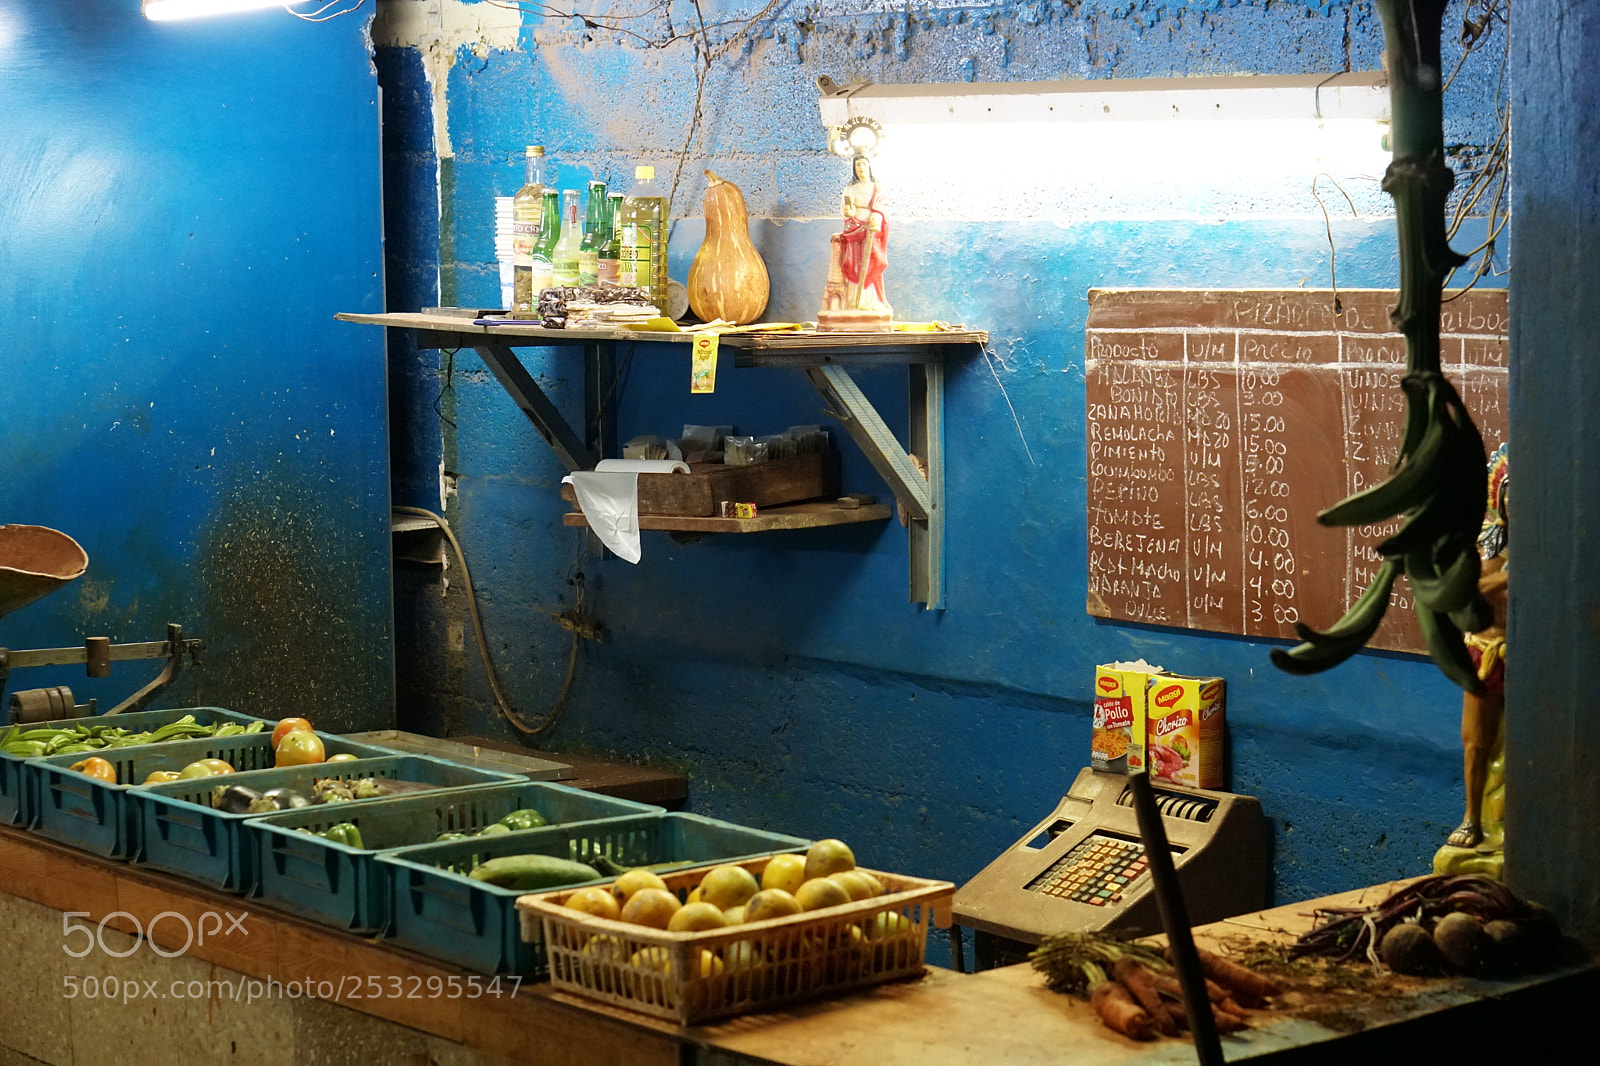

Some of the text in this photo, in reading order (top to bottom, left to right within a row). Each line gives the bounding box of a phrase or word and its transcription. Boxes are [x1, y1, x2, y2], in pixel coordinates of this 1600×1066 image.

[1187, 370, 1220, 389] LBS
[1243, 413, 1285, 432] 15.00
[1244, 434, 1287, 455] 15.00
[1190, 446, 1221, 468] U/M
[1245, 454, 1284, 474] 5.00
[1245, 499, 1288, 522] 6.00
[1193, 535, 1223, 559] U/M
[1249, 548, 1296, 574] 4.00
[1193, 563, 1226, 588] U/M
[1249, 576, 1295, 598] 4.00
[1089, 574, 1162, 600] NARANJA
[1194, 593, 1224, 614] U/M
[1104, 707, 1129, 721] Pollo
[1112, 720, 1131, 729] Tomate
[1156, 715, 1188, 736] Chorizo
